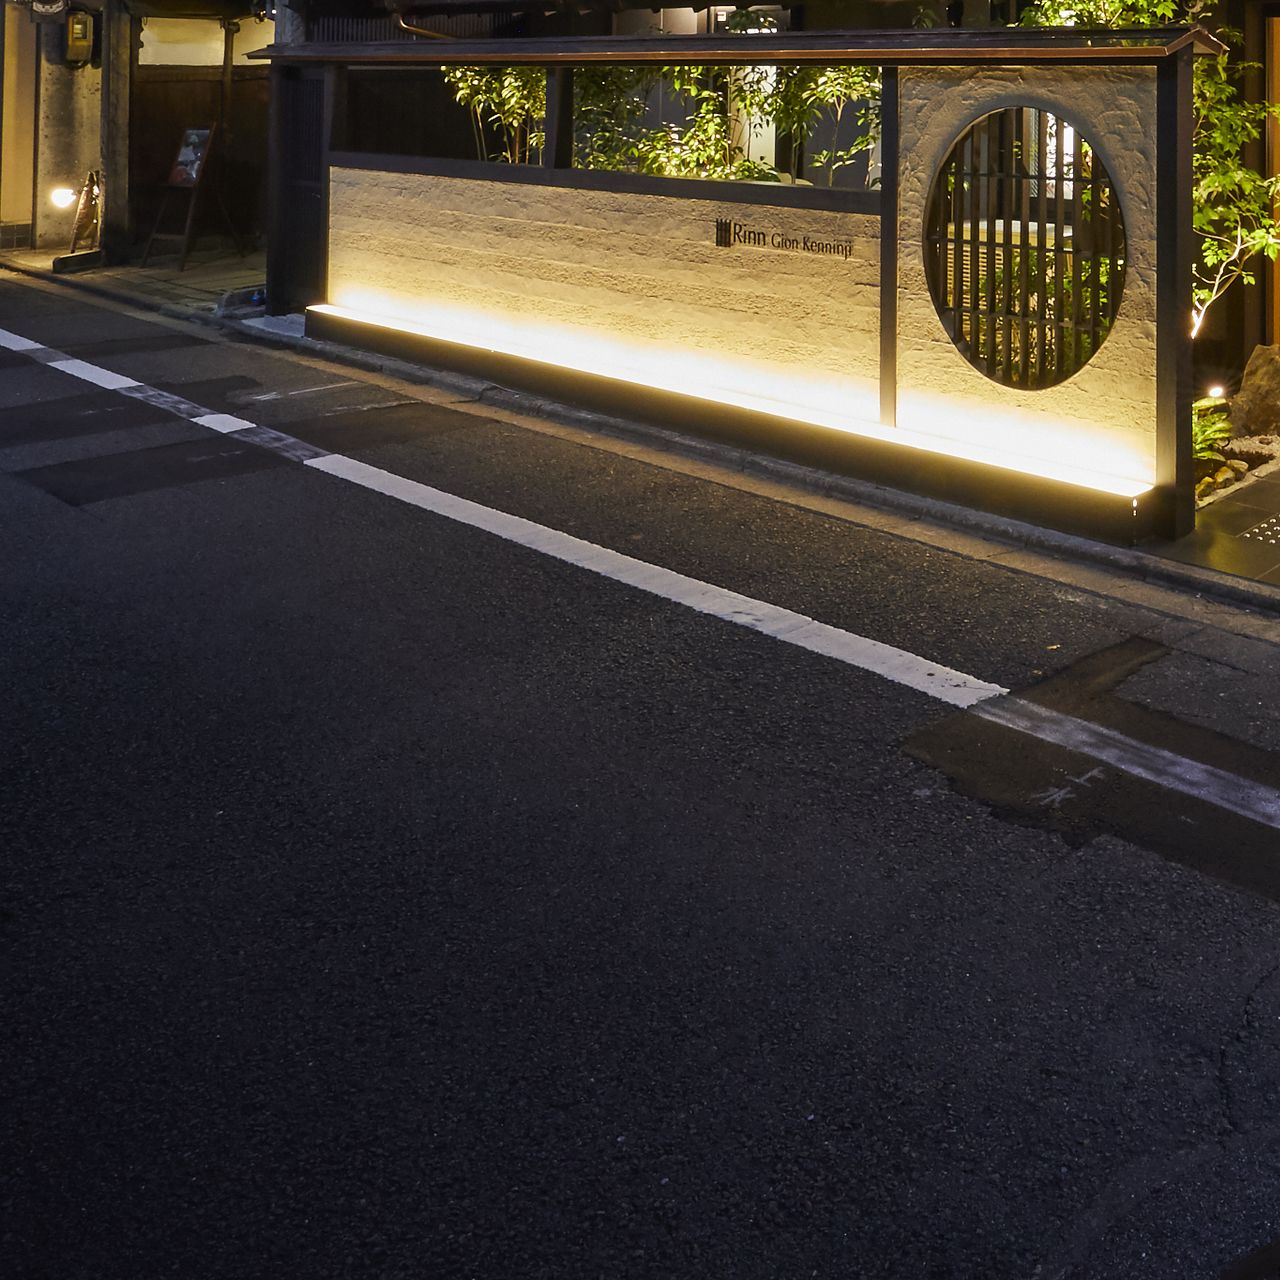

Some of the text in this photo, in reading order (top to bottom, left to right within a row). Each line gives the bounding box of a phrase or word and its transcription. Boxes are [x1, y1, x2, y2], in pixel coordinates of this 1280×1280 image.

[733, 222, 852, 260] Rinn Gion Kenninji
